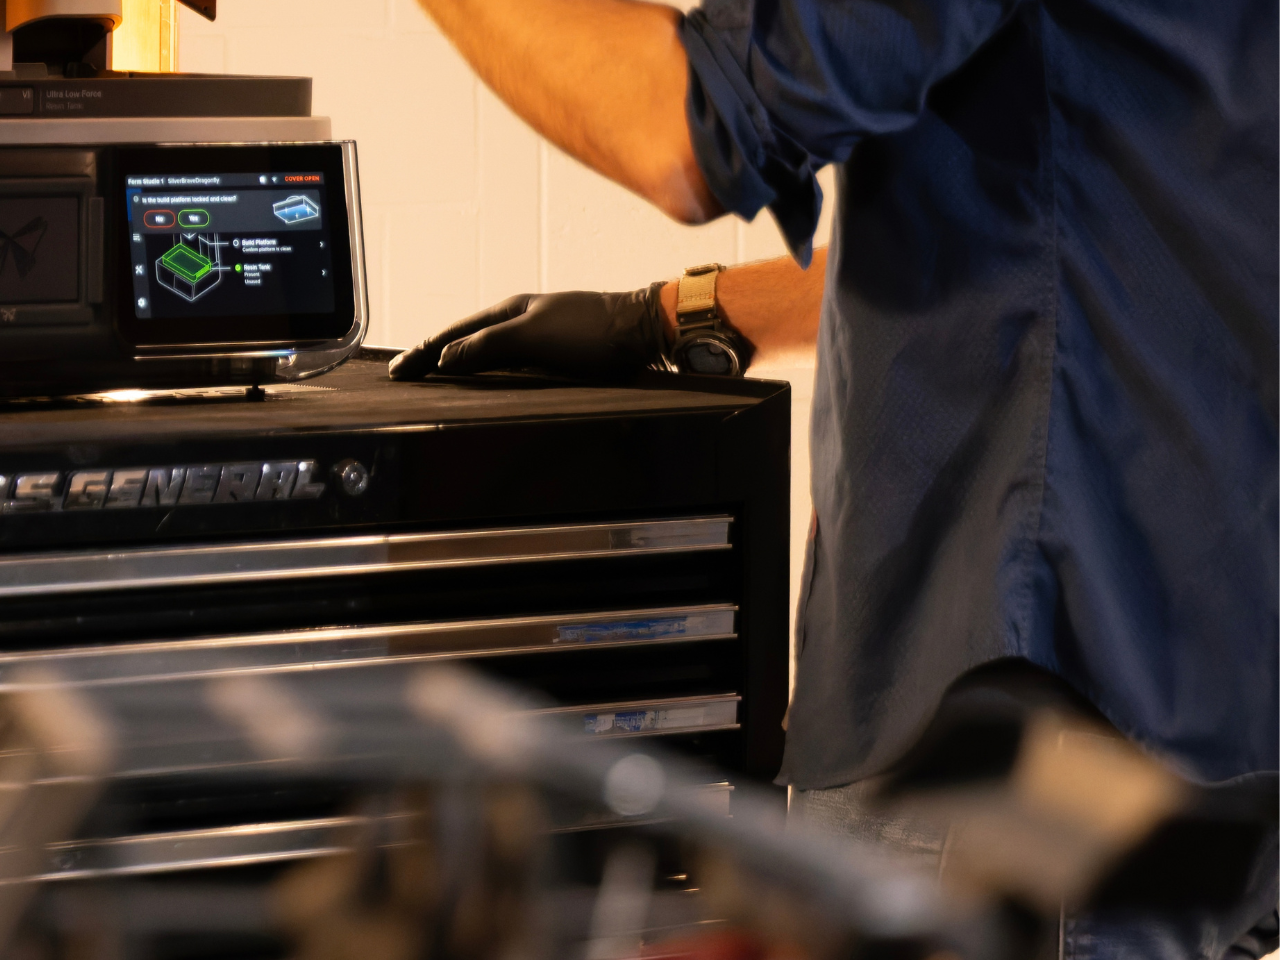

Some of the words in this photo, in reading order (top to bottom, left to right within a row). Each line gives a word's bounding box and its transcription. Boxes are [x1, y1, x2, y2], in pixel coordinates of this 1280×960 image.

[46, 90, 63, 98] Ultra
[65, 90, 80, 98] Low
[81, 90, 102, 98] Force
[188, 214, 198, 222] Yes
